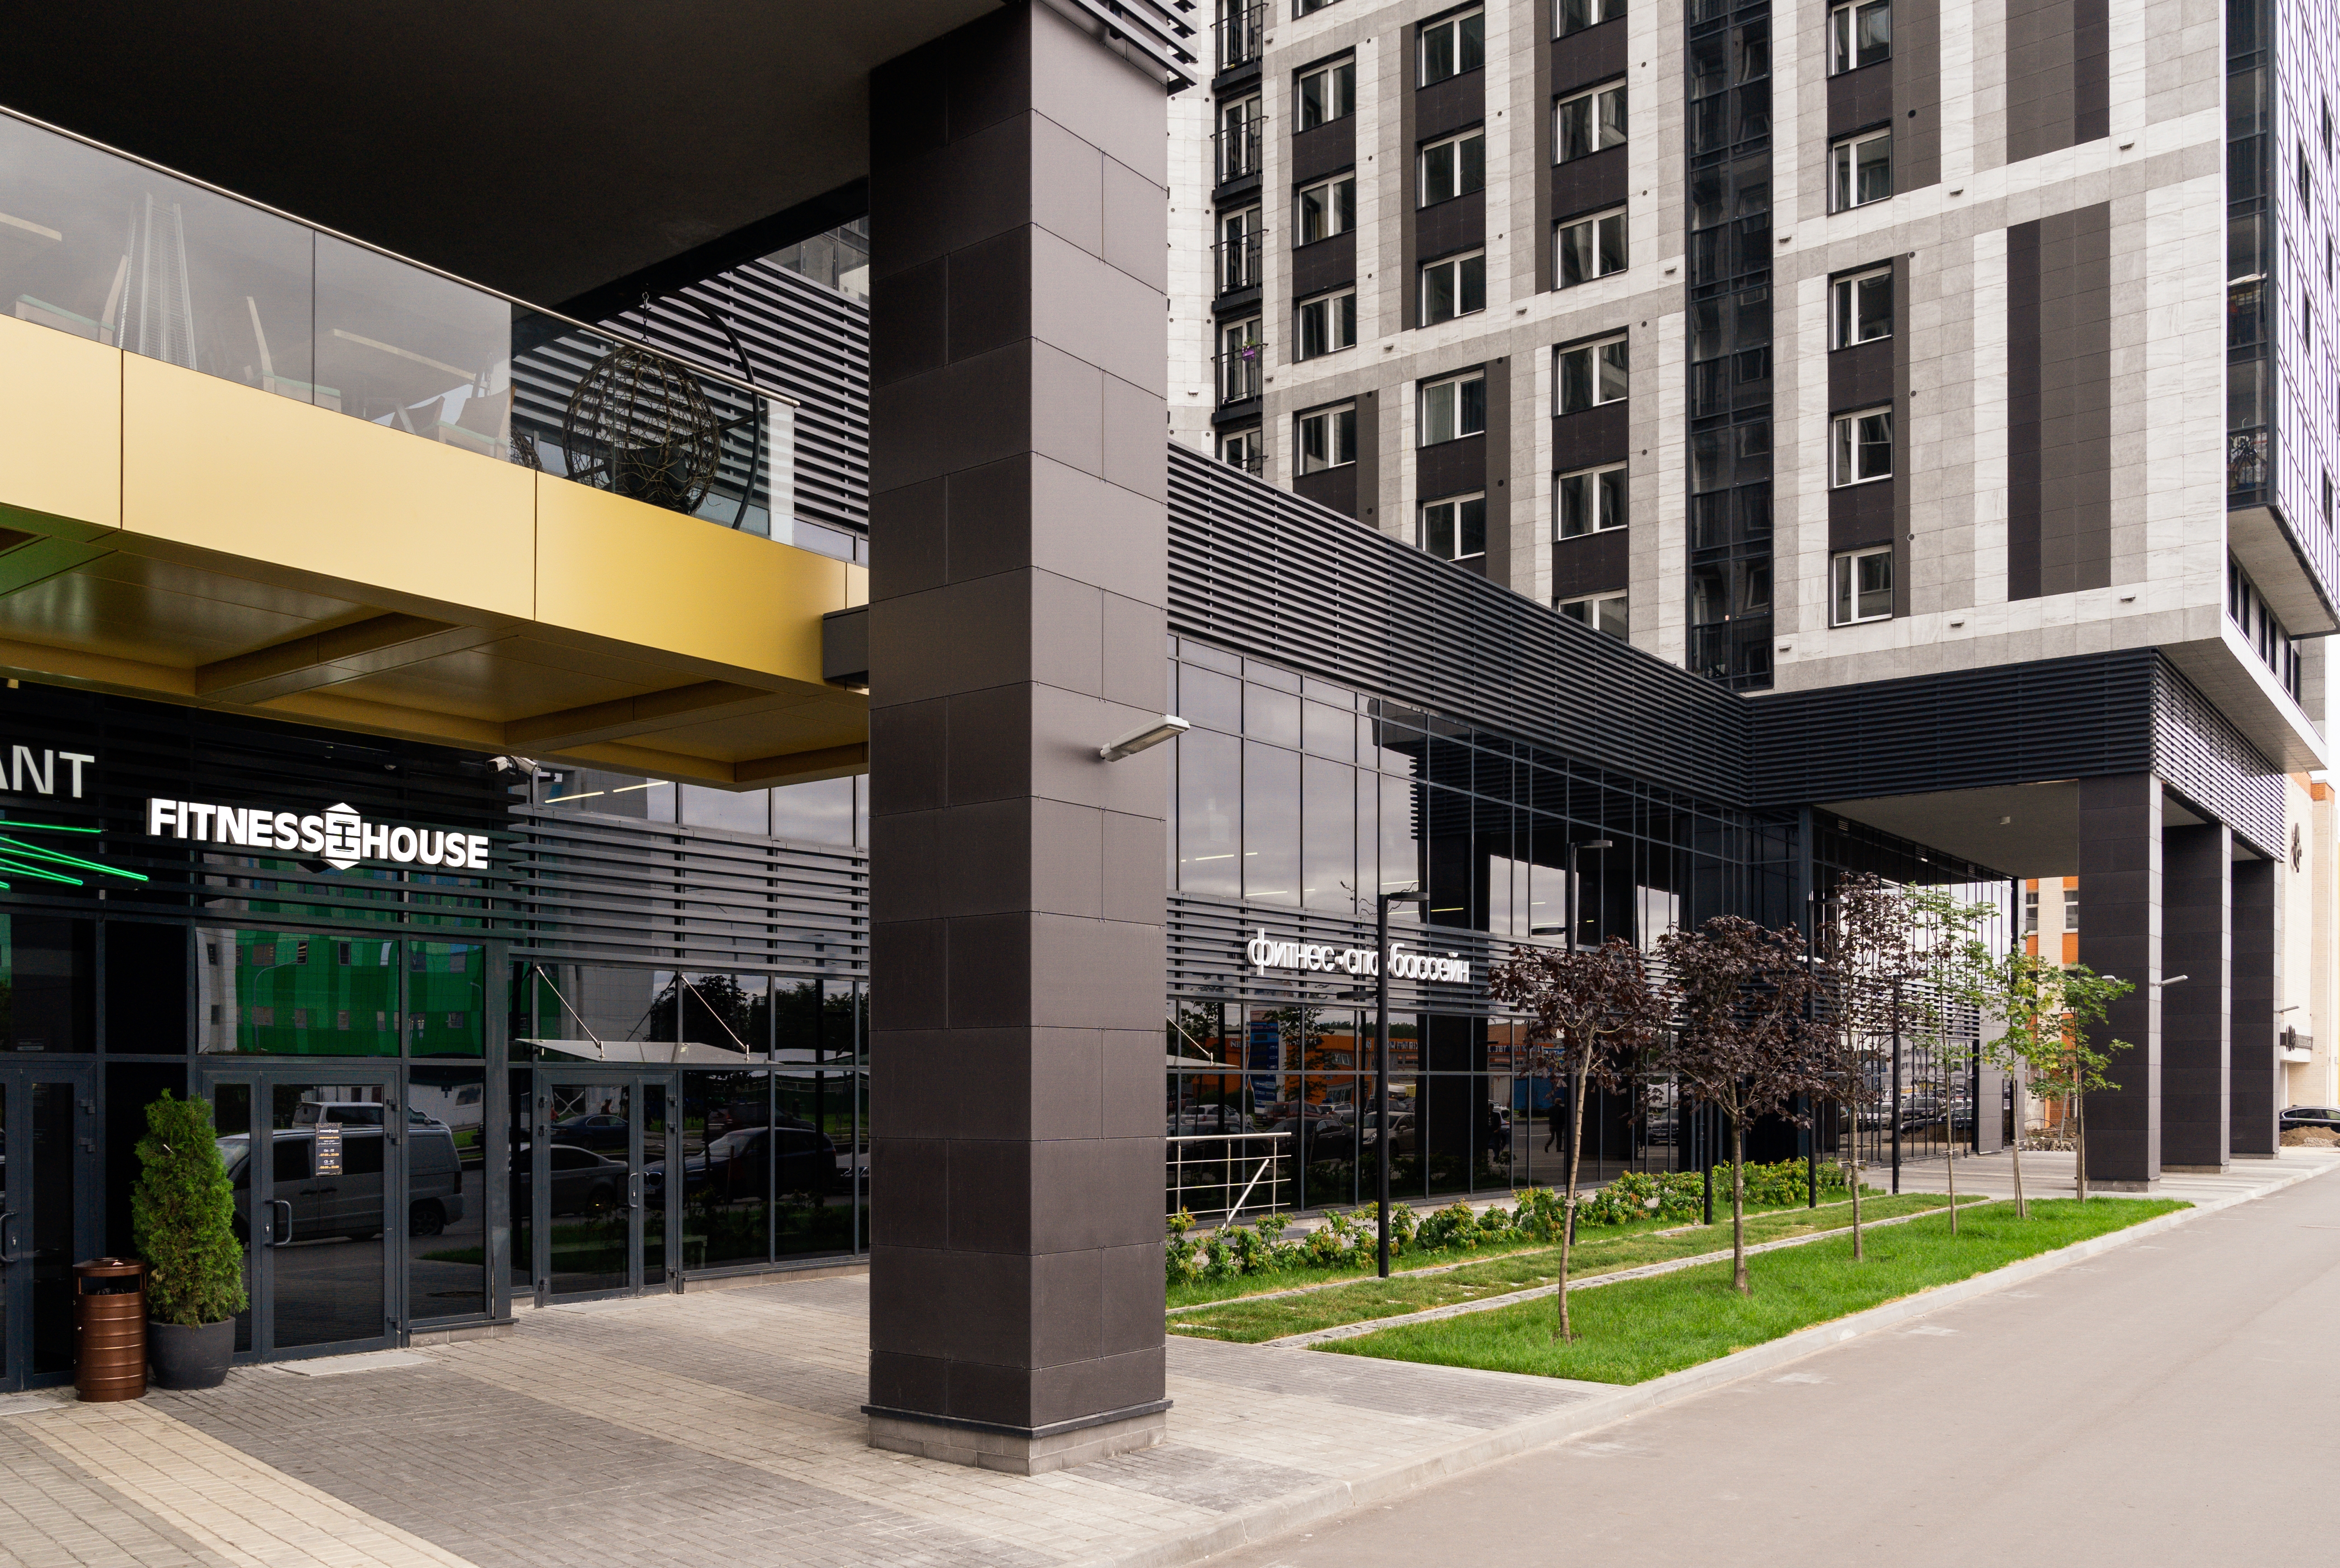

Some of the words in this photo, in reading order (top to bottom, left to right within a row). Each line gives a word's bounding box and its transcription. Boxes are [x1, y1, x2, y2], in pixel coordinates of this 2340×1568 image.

[0, 744, 95, 798] NT
[146, 798, 325, 852] FITNESS
[361, 822, 489, 870] HOUSE
[1247, 927, 1335, 976] фитнес
[1389, 943, 1470, 983] бассейн
